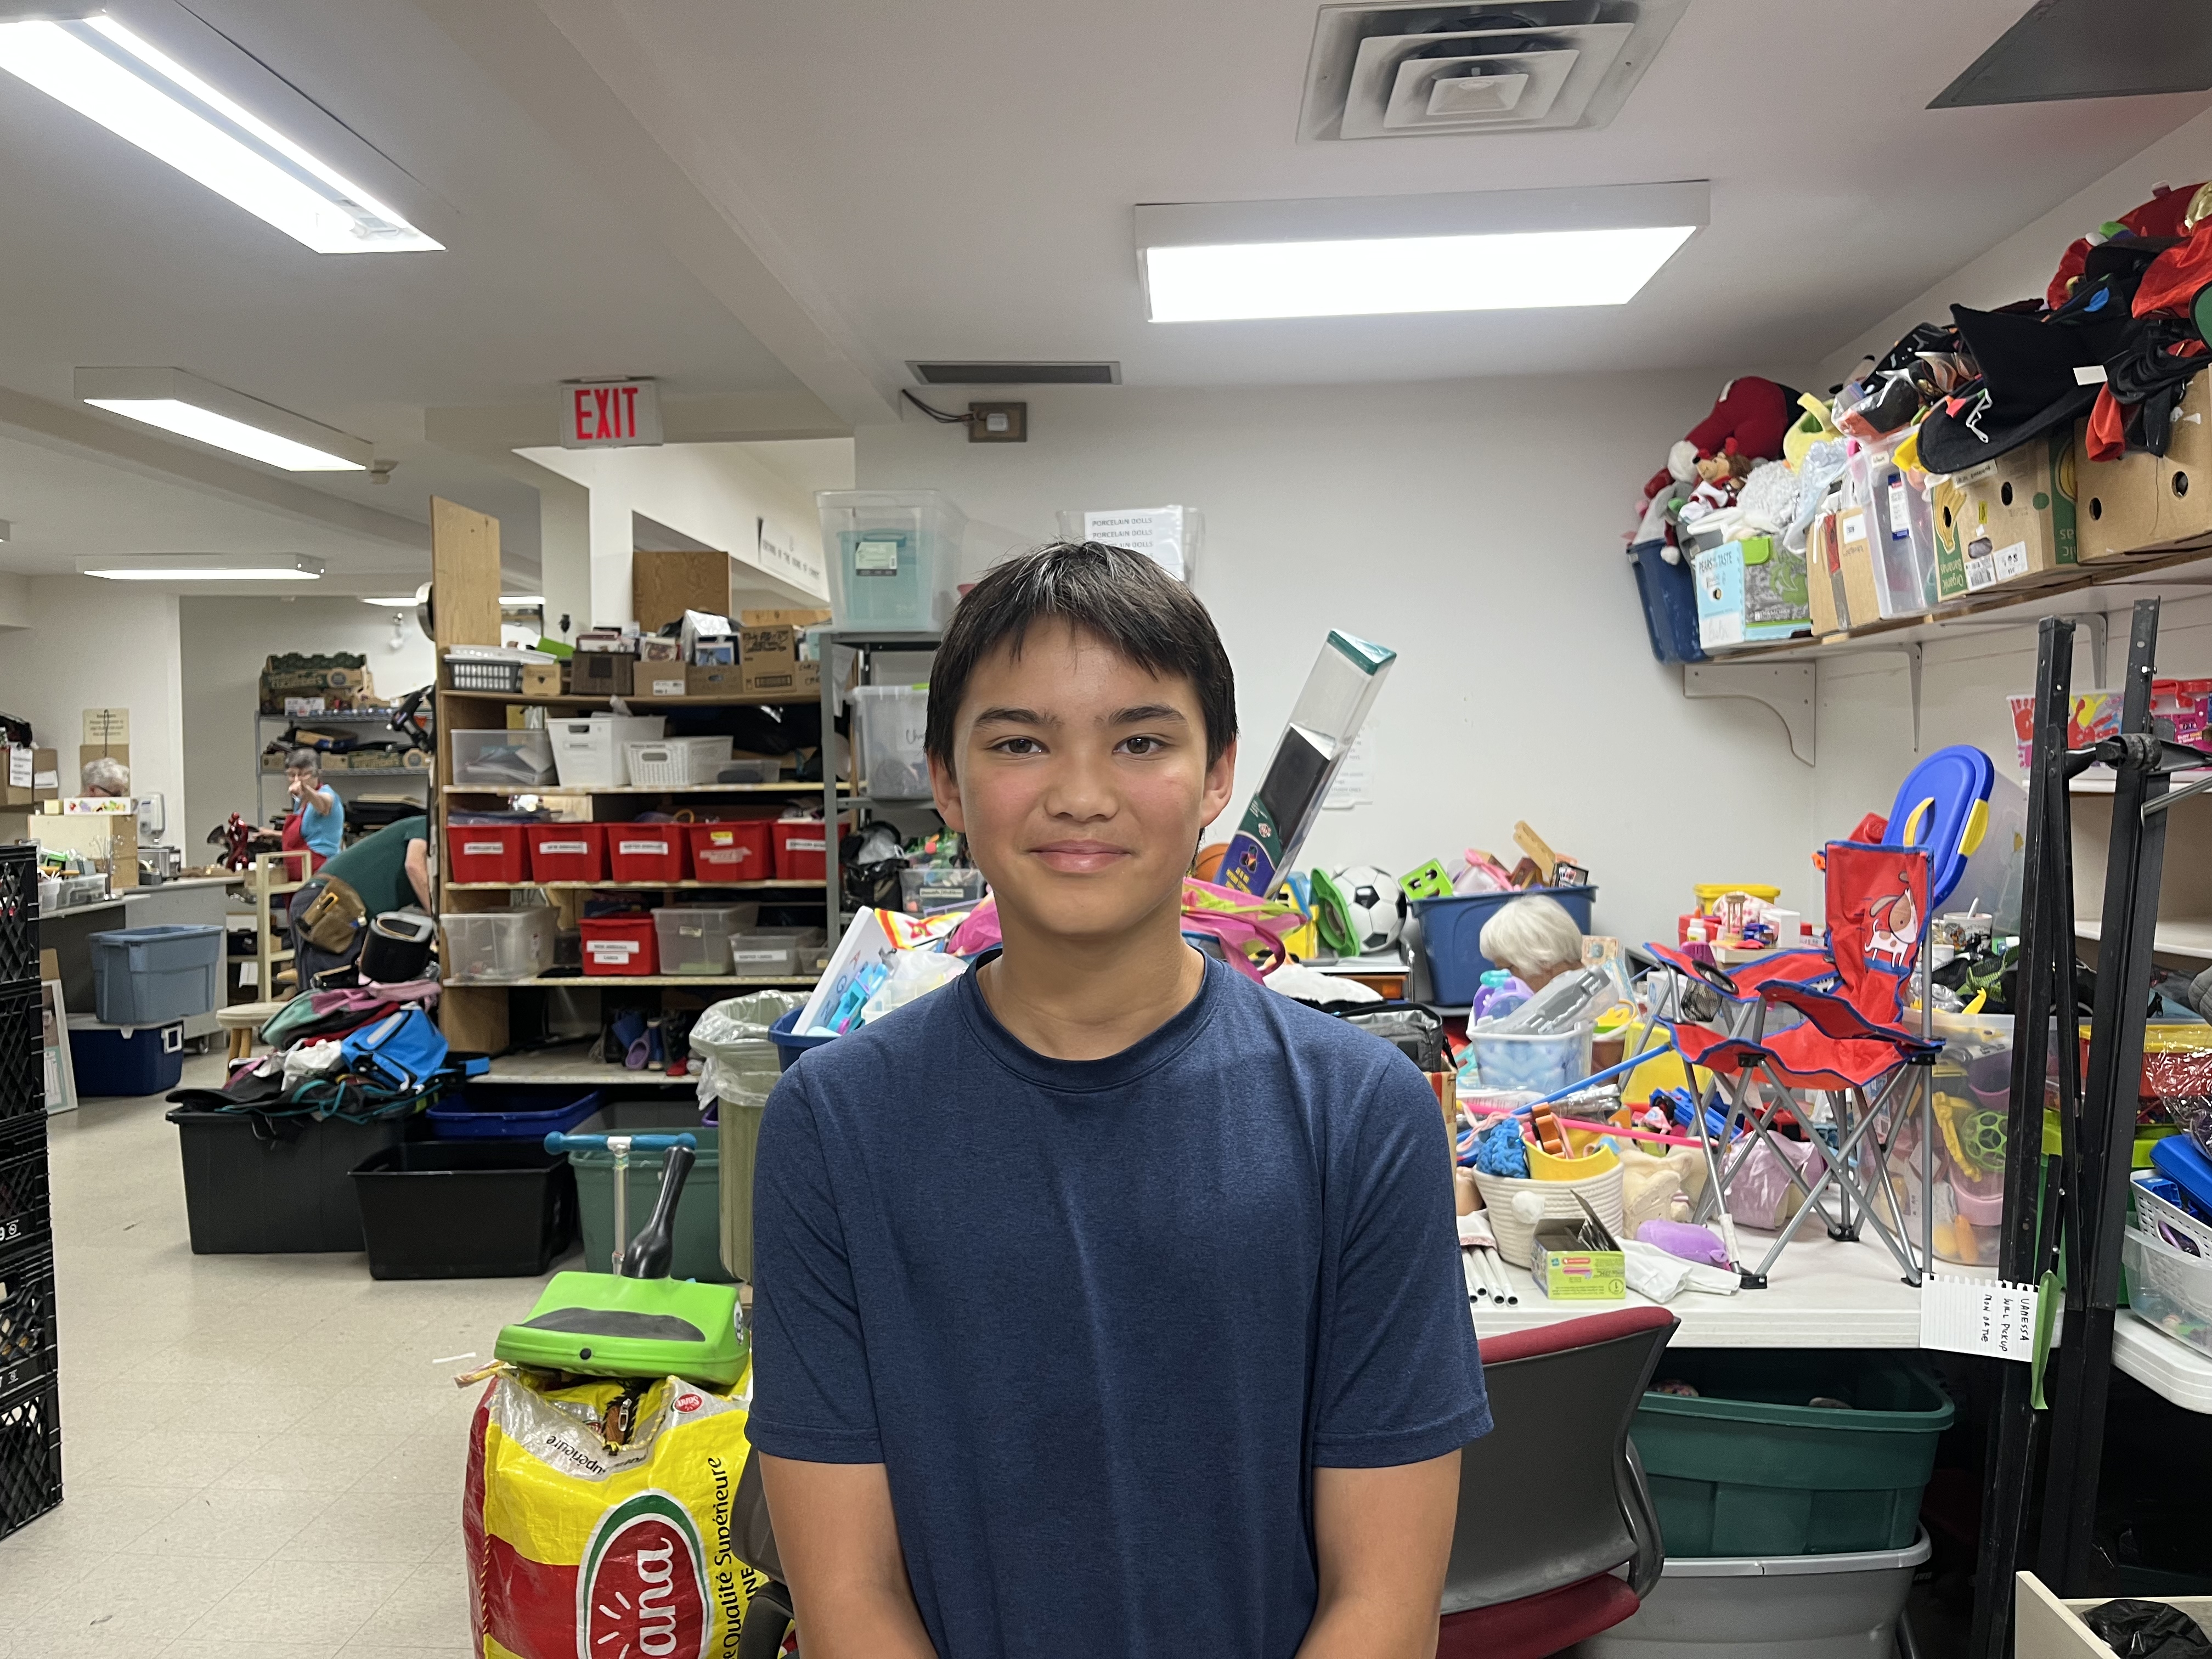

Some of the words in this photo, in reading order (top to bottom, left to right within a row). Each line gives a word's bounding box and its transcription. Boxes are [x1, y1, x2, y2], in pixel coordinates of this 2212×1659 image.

[574, 386, 639, 439] EXIT
[1092, 518, 1129, 527] PORCELAIN
[1717, 551, 1733, 566] TASTE
[1940, 558, 1962, 575] Bananas
[1942, 572, 1964, 593] Organic
[1983, 1294, 1993, 1312] MON
[676, 1395, 700, 1407] Sana
[546, 1435, 606, 1475] upérieure
[708, 1457, 732, 1567] Supérieure
[636, 1537, 677, 1659] ana
[715, 1571, 741, 1649] Qualité
